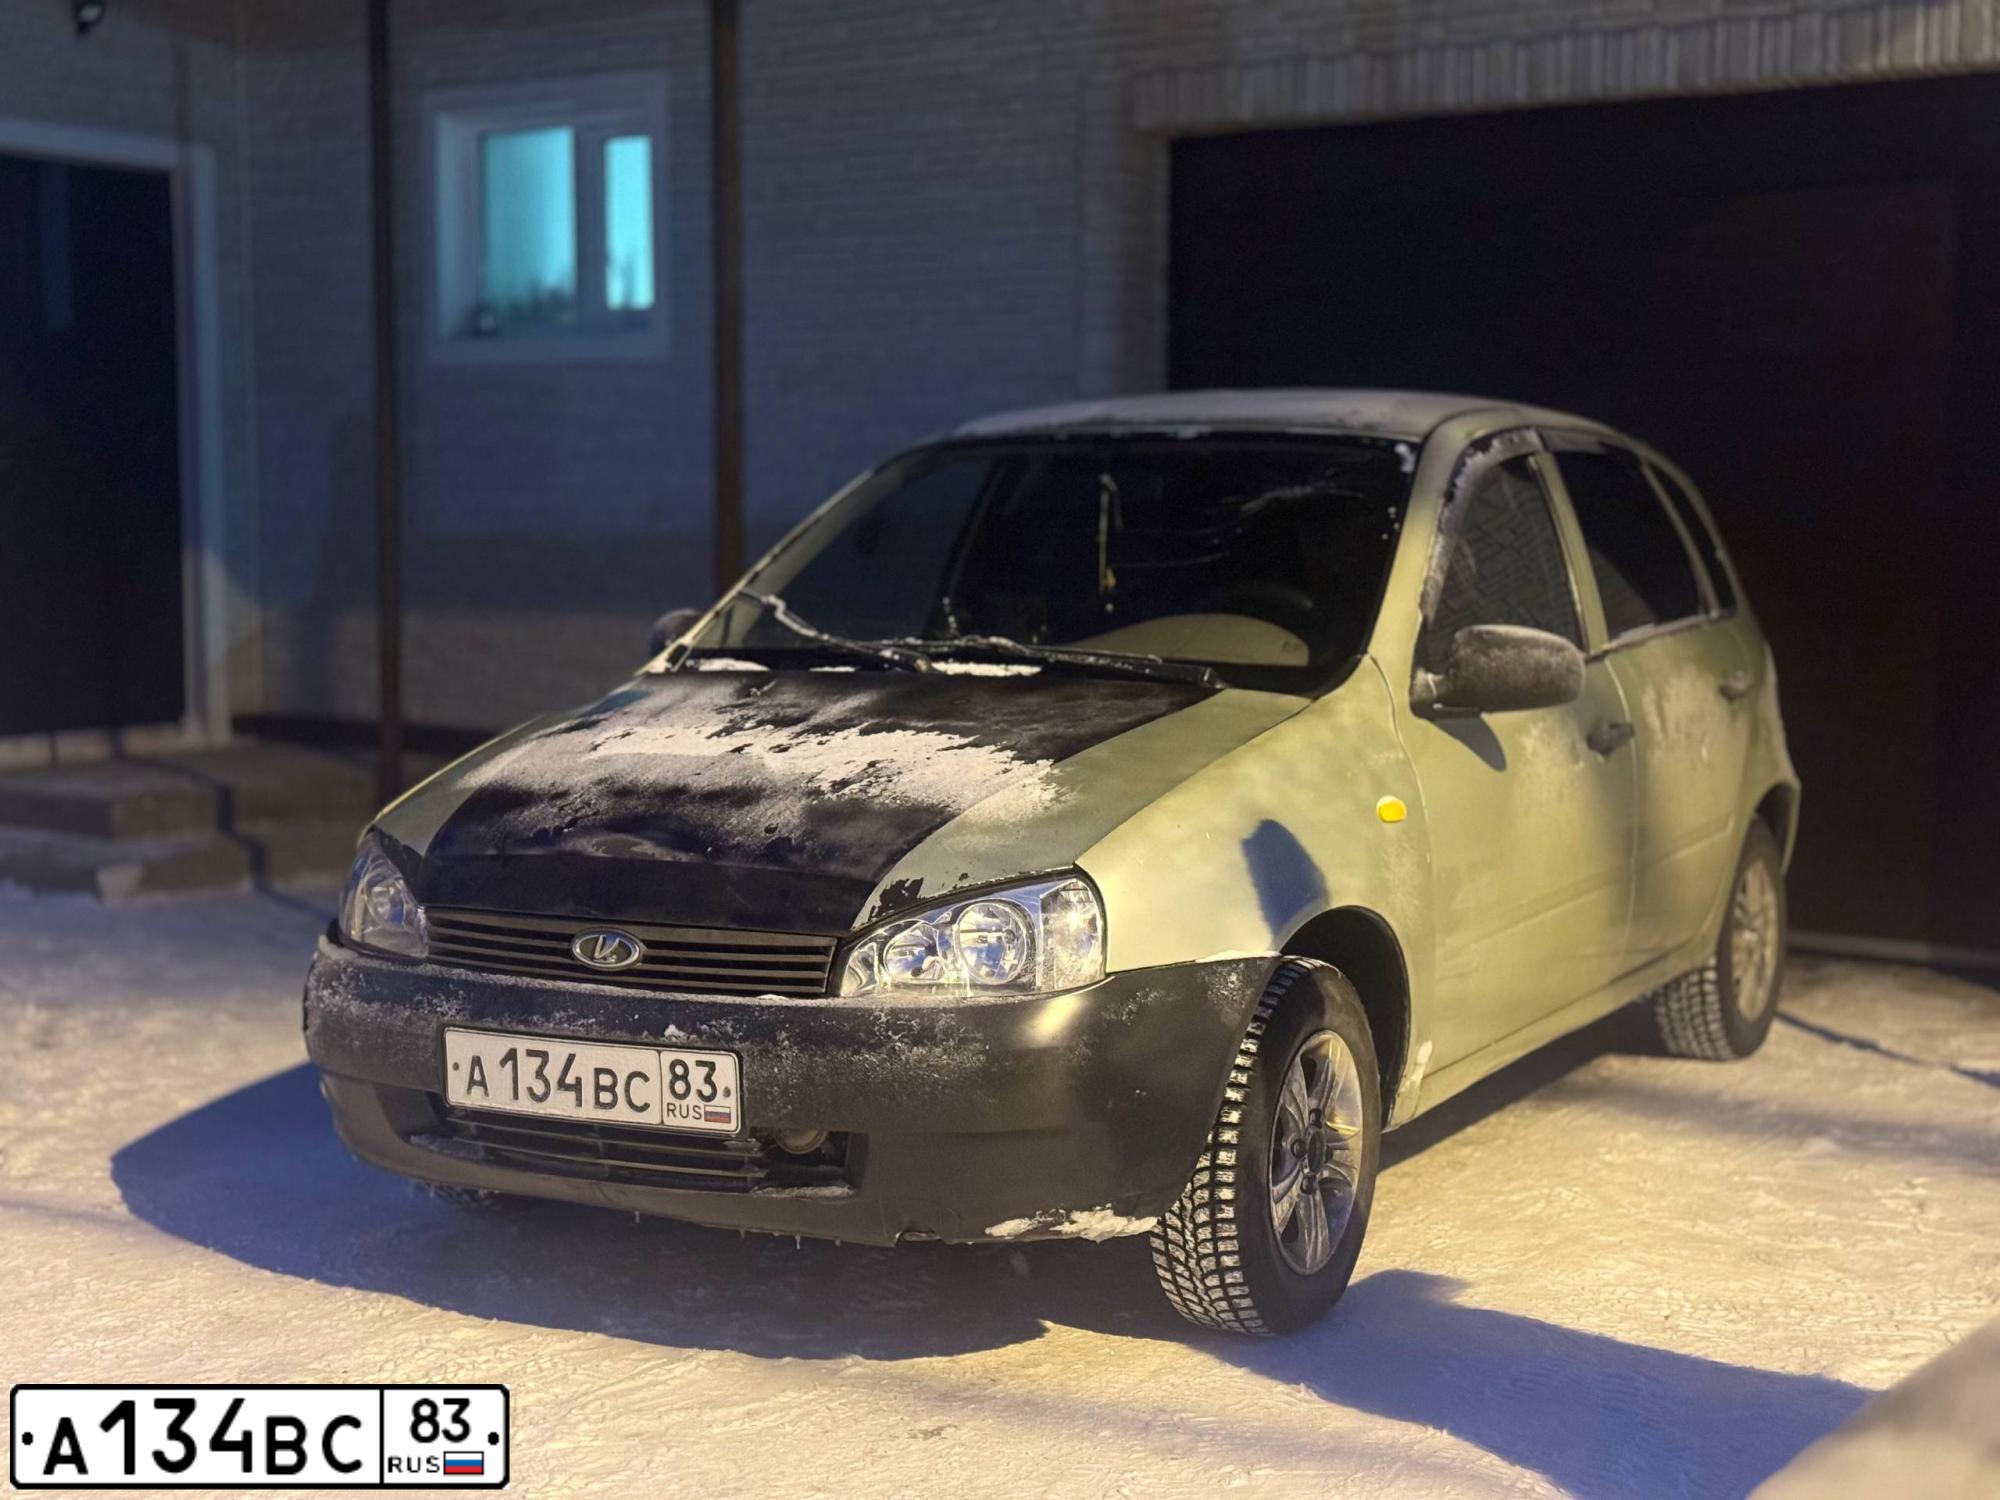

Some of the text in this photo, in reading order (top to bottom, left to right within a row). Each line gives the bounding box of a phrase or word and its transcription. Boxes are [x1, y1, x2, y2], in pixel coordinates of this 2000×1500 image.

[466, 1047, 718, 1113] А134ВС 83
[666, 1102, 702, 1121] RUS
